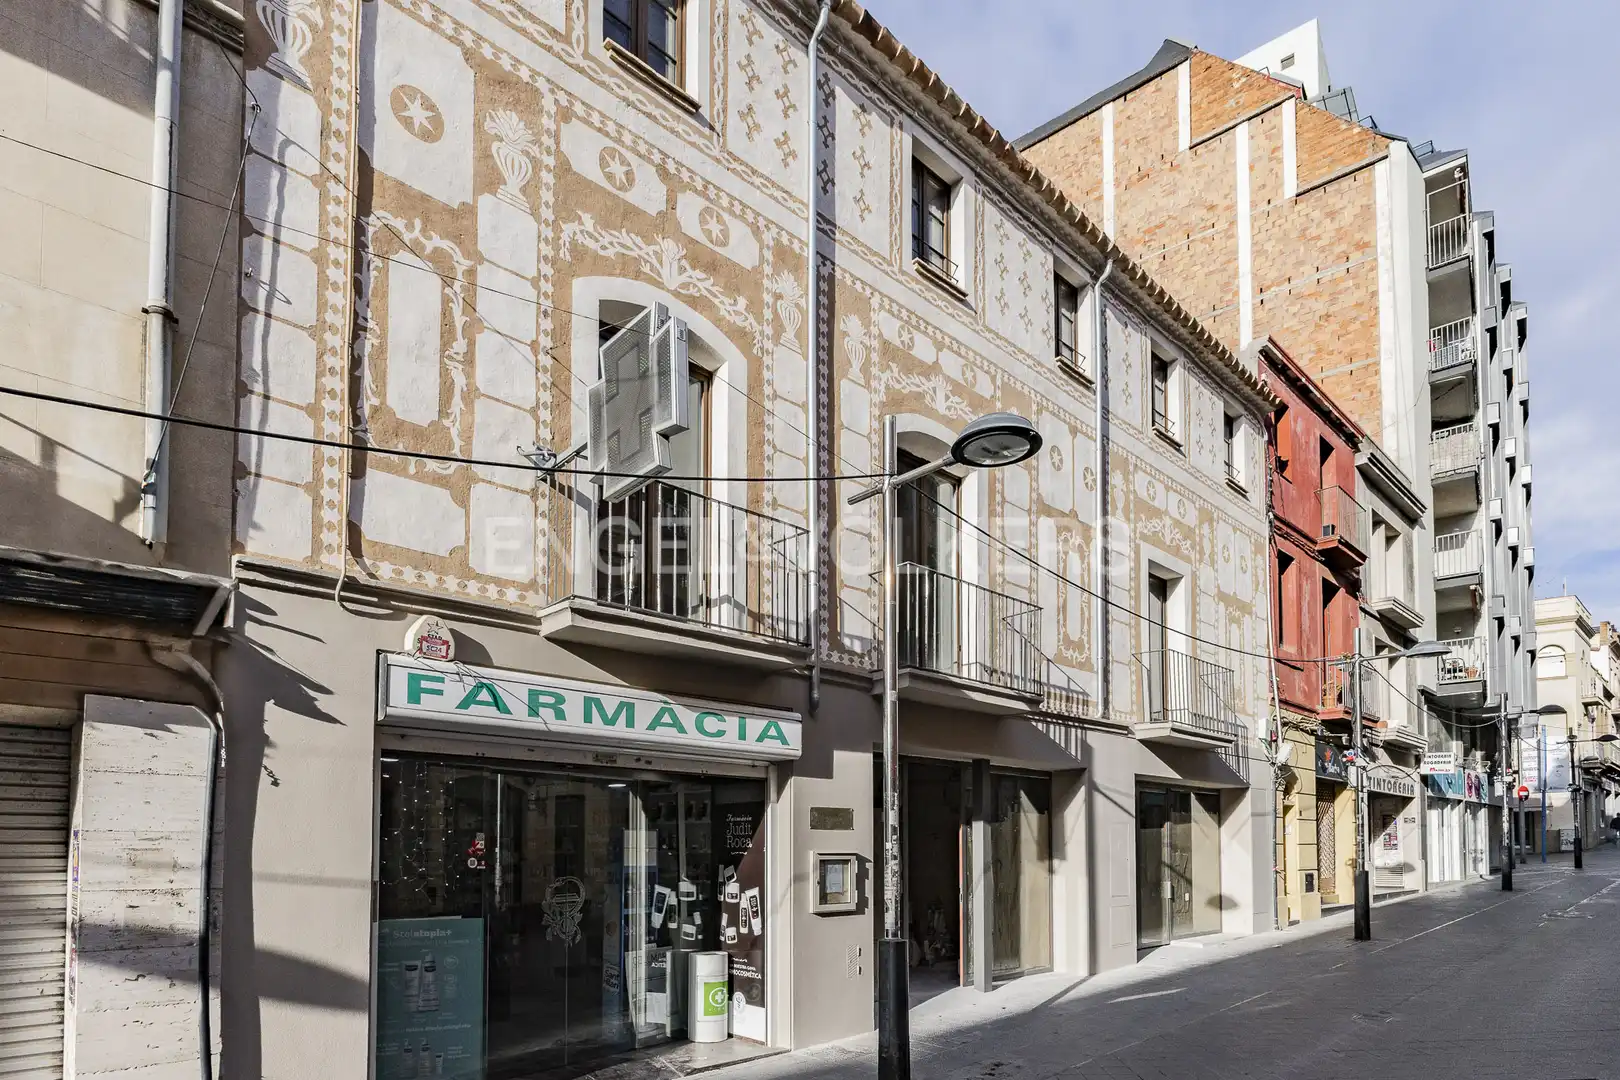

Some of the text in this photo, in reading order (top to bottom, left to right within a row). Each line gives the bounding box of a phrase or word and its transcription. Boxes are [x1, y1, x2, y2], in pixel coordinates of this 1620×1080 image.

[406, 671, 791, 747] FARMÀCIA
[726, 822, 753, 836] Judit
[726, 835, 753, 848] Roca
